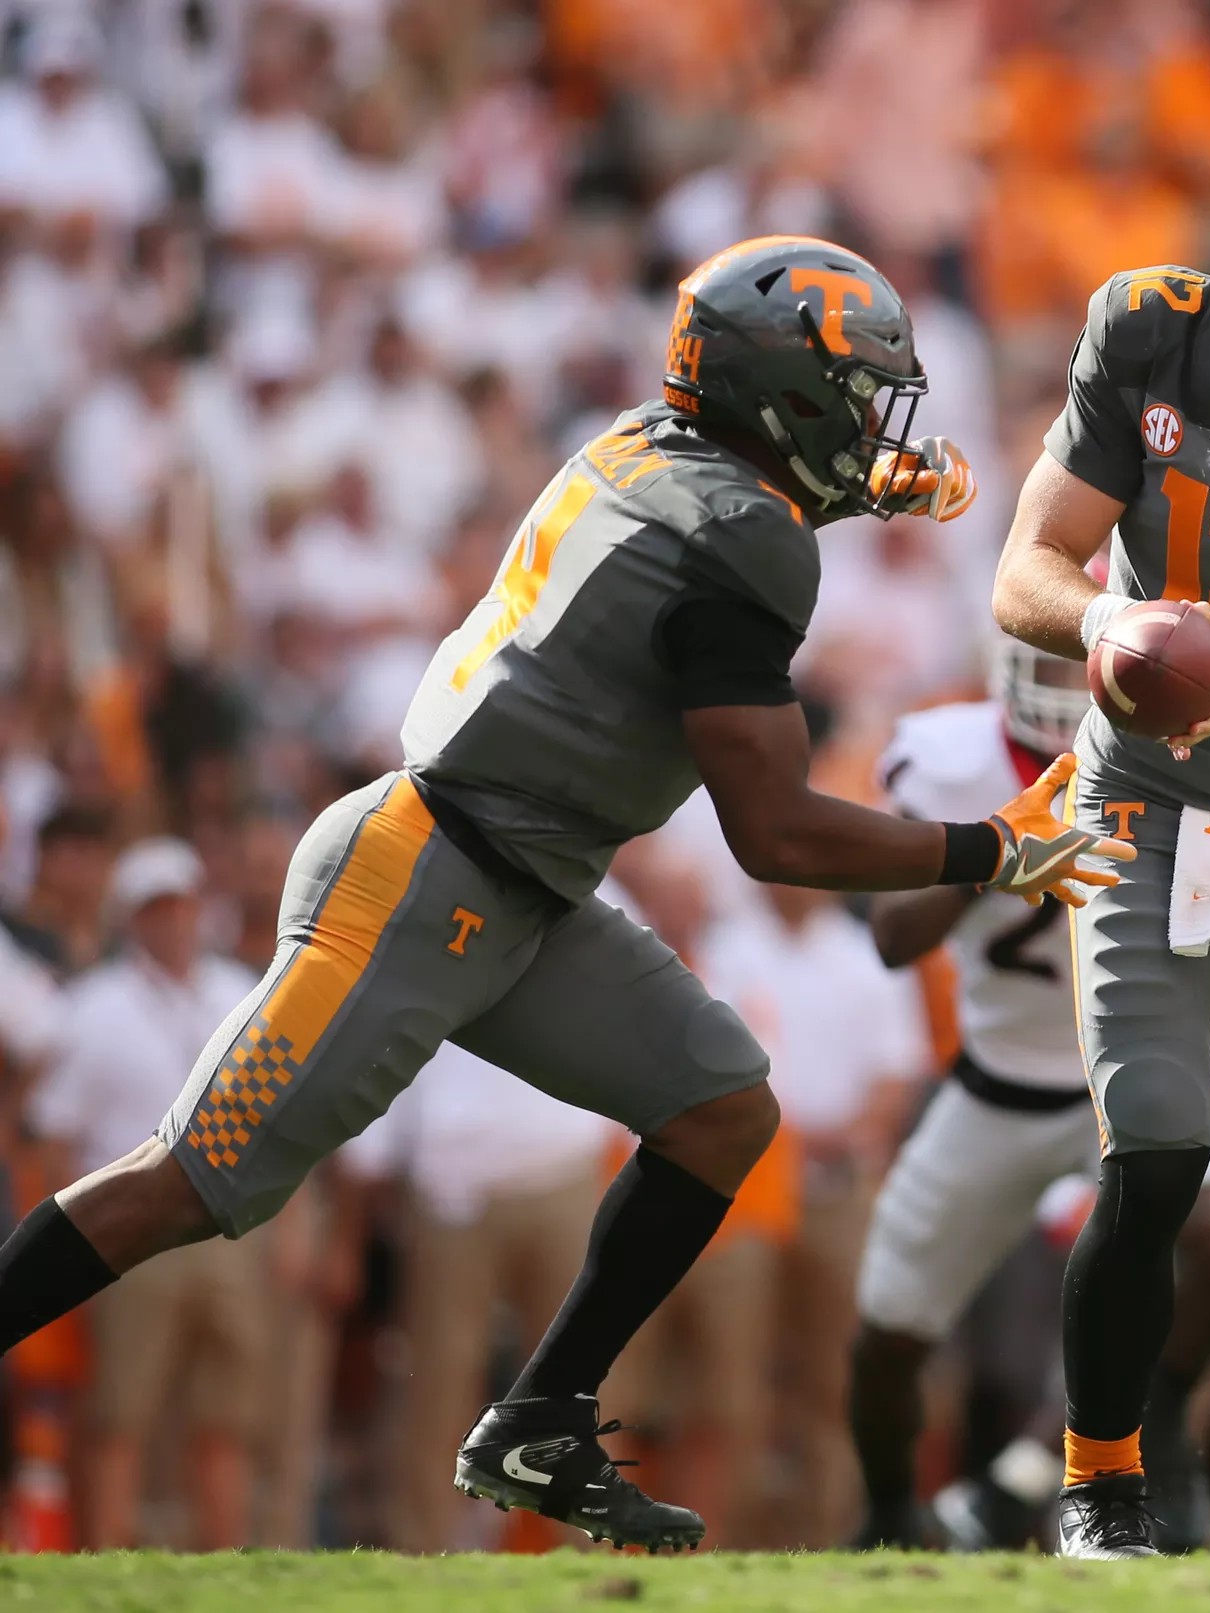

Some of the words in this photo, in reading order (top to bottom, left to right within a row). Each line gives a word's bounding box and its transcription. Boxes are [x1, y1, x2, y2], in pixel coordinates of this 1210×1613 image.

[790, 268, 873, 356] T
[1145, 407, 1180, 453] SEC
[1104, 801, 1146, 840] T
[446, 906, 484, 956] T
